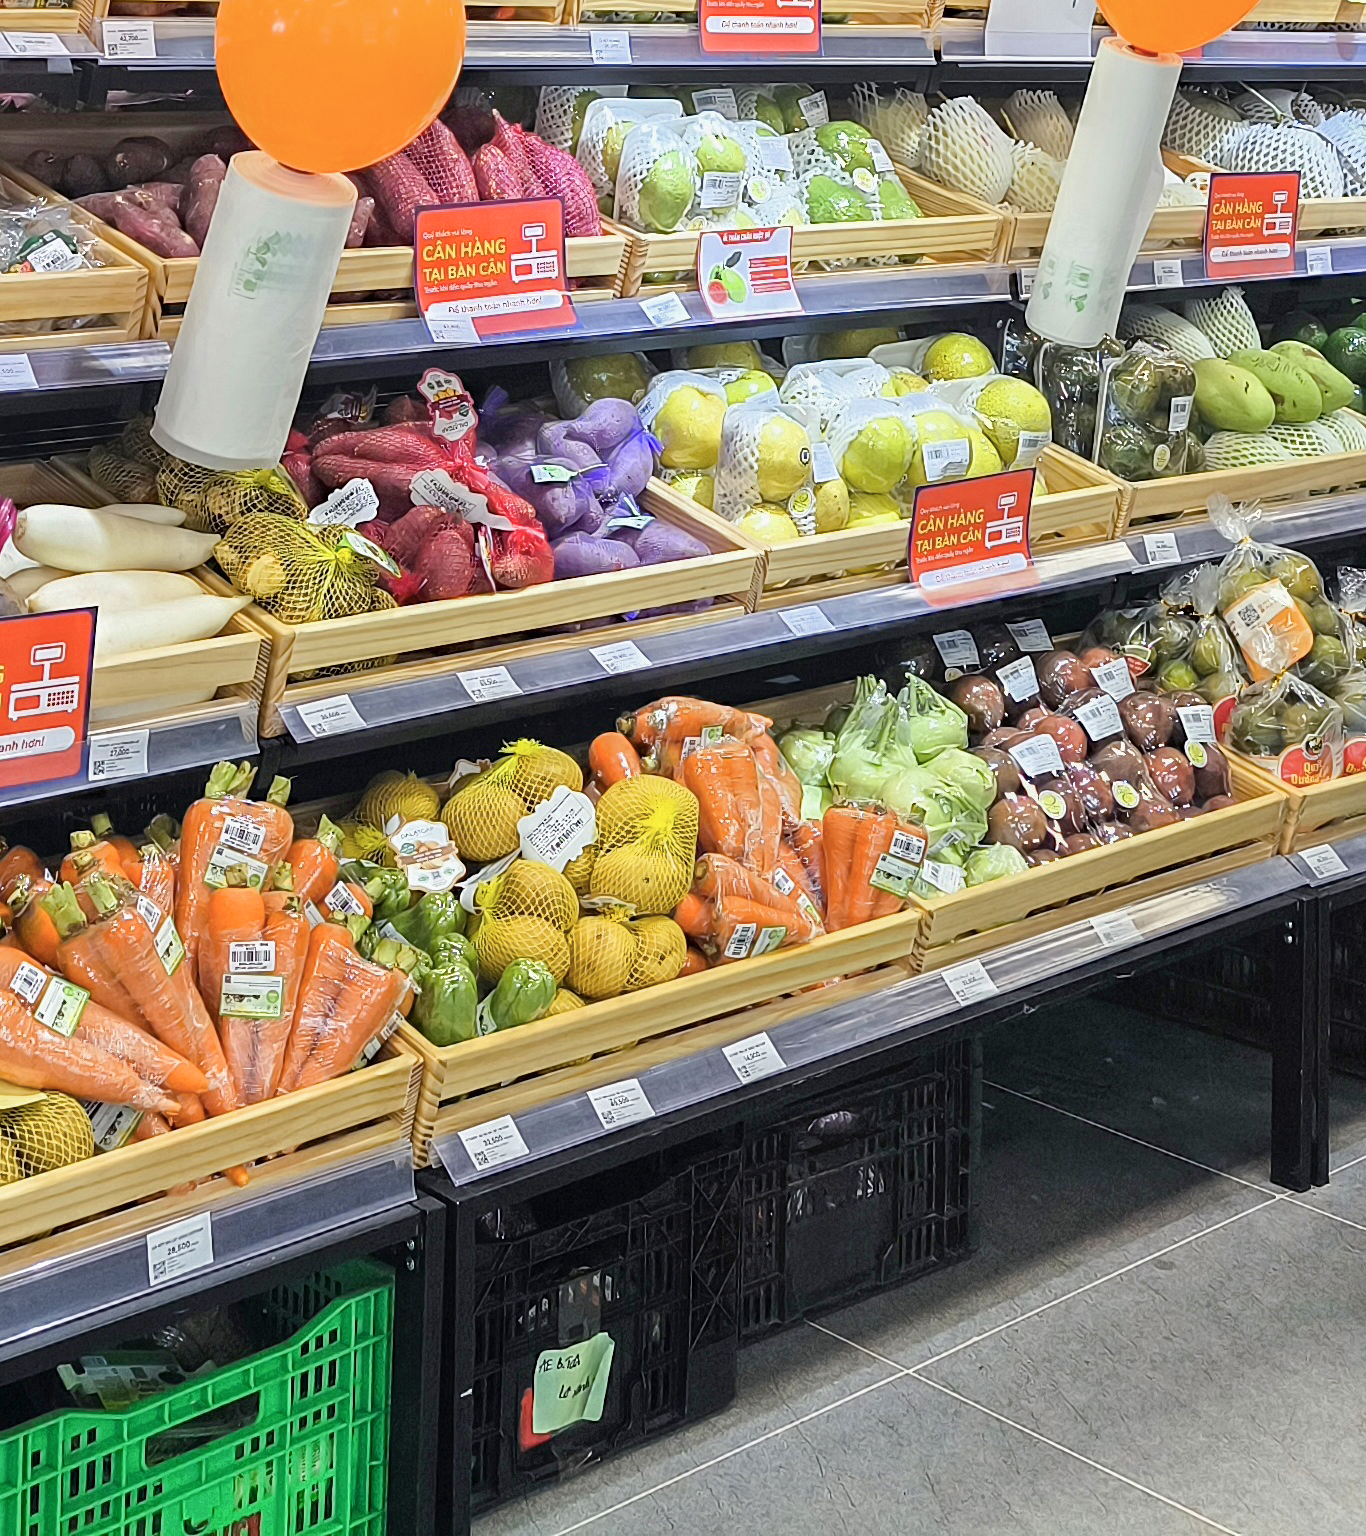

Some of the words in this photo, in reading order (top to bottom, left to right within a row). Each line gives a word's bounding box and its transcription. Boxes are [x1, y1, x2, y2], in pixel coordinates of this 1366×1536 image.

[422, 242, 456, 262] CÂN
[461, 237, 506, 258] HÀNG
[423, 267, 444, 284] TẠI
[448, 261, 476, 279] BÀN
[479, 258, 507, 274] CÂN
[917, 515, 944, 534] CÂN
[947, 508, 985, 529] HÀNG
[916, 538, 933, 555] TẠI
[935, 532, 957, 548] BÀN
[960, 526, 982, 543] CÂN
